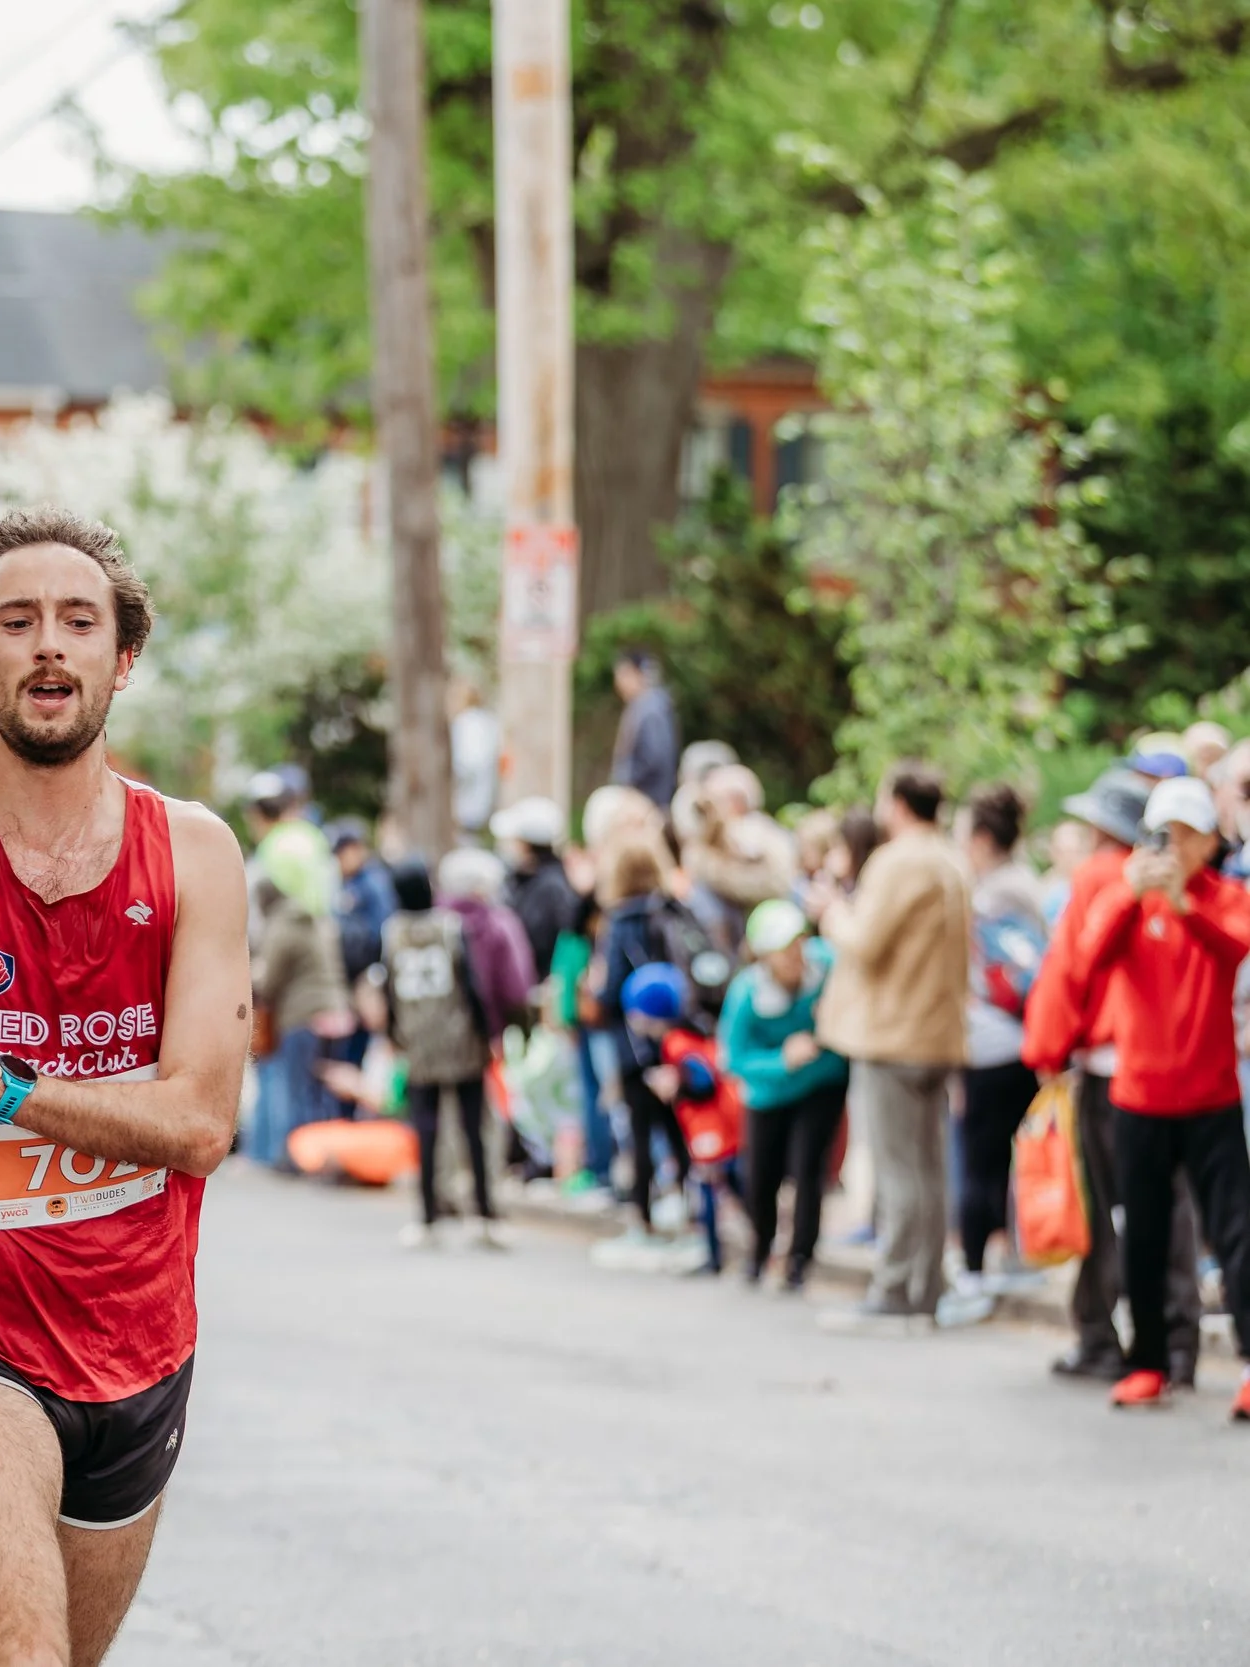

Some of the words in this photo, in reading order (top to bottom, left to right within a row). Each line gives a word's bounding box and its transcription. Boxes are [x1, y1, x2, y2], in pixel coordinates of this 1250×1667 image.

[59, 1002, 156, 1046] ROSE
[78, 1046, 138, 1073] Club
[0, 1208, 29, 1219] ywca
